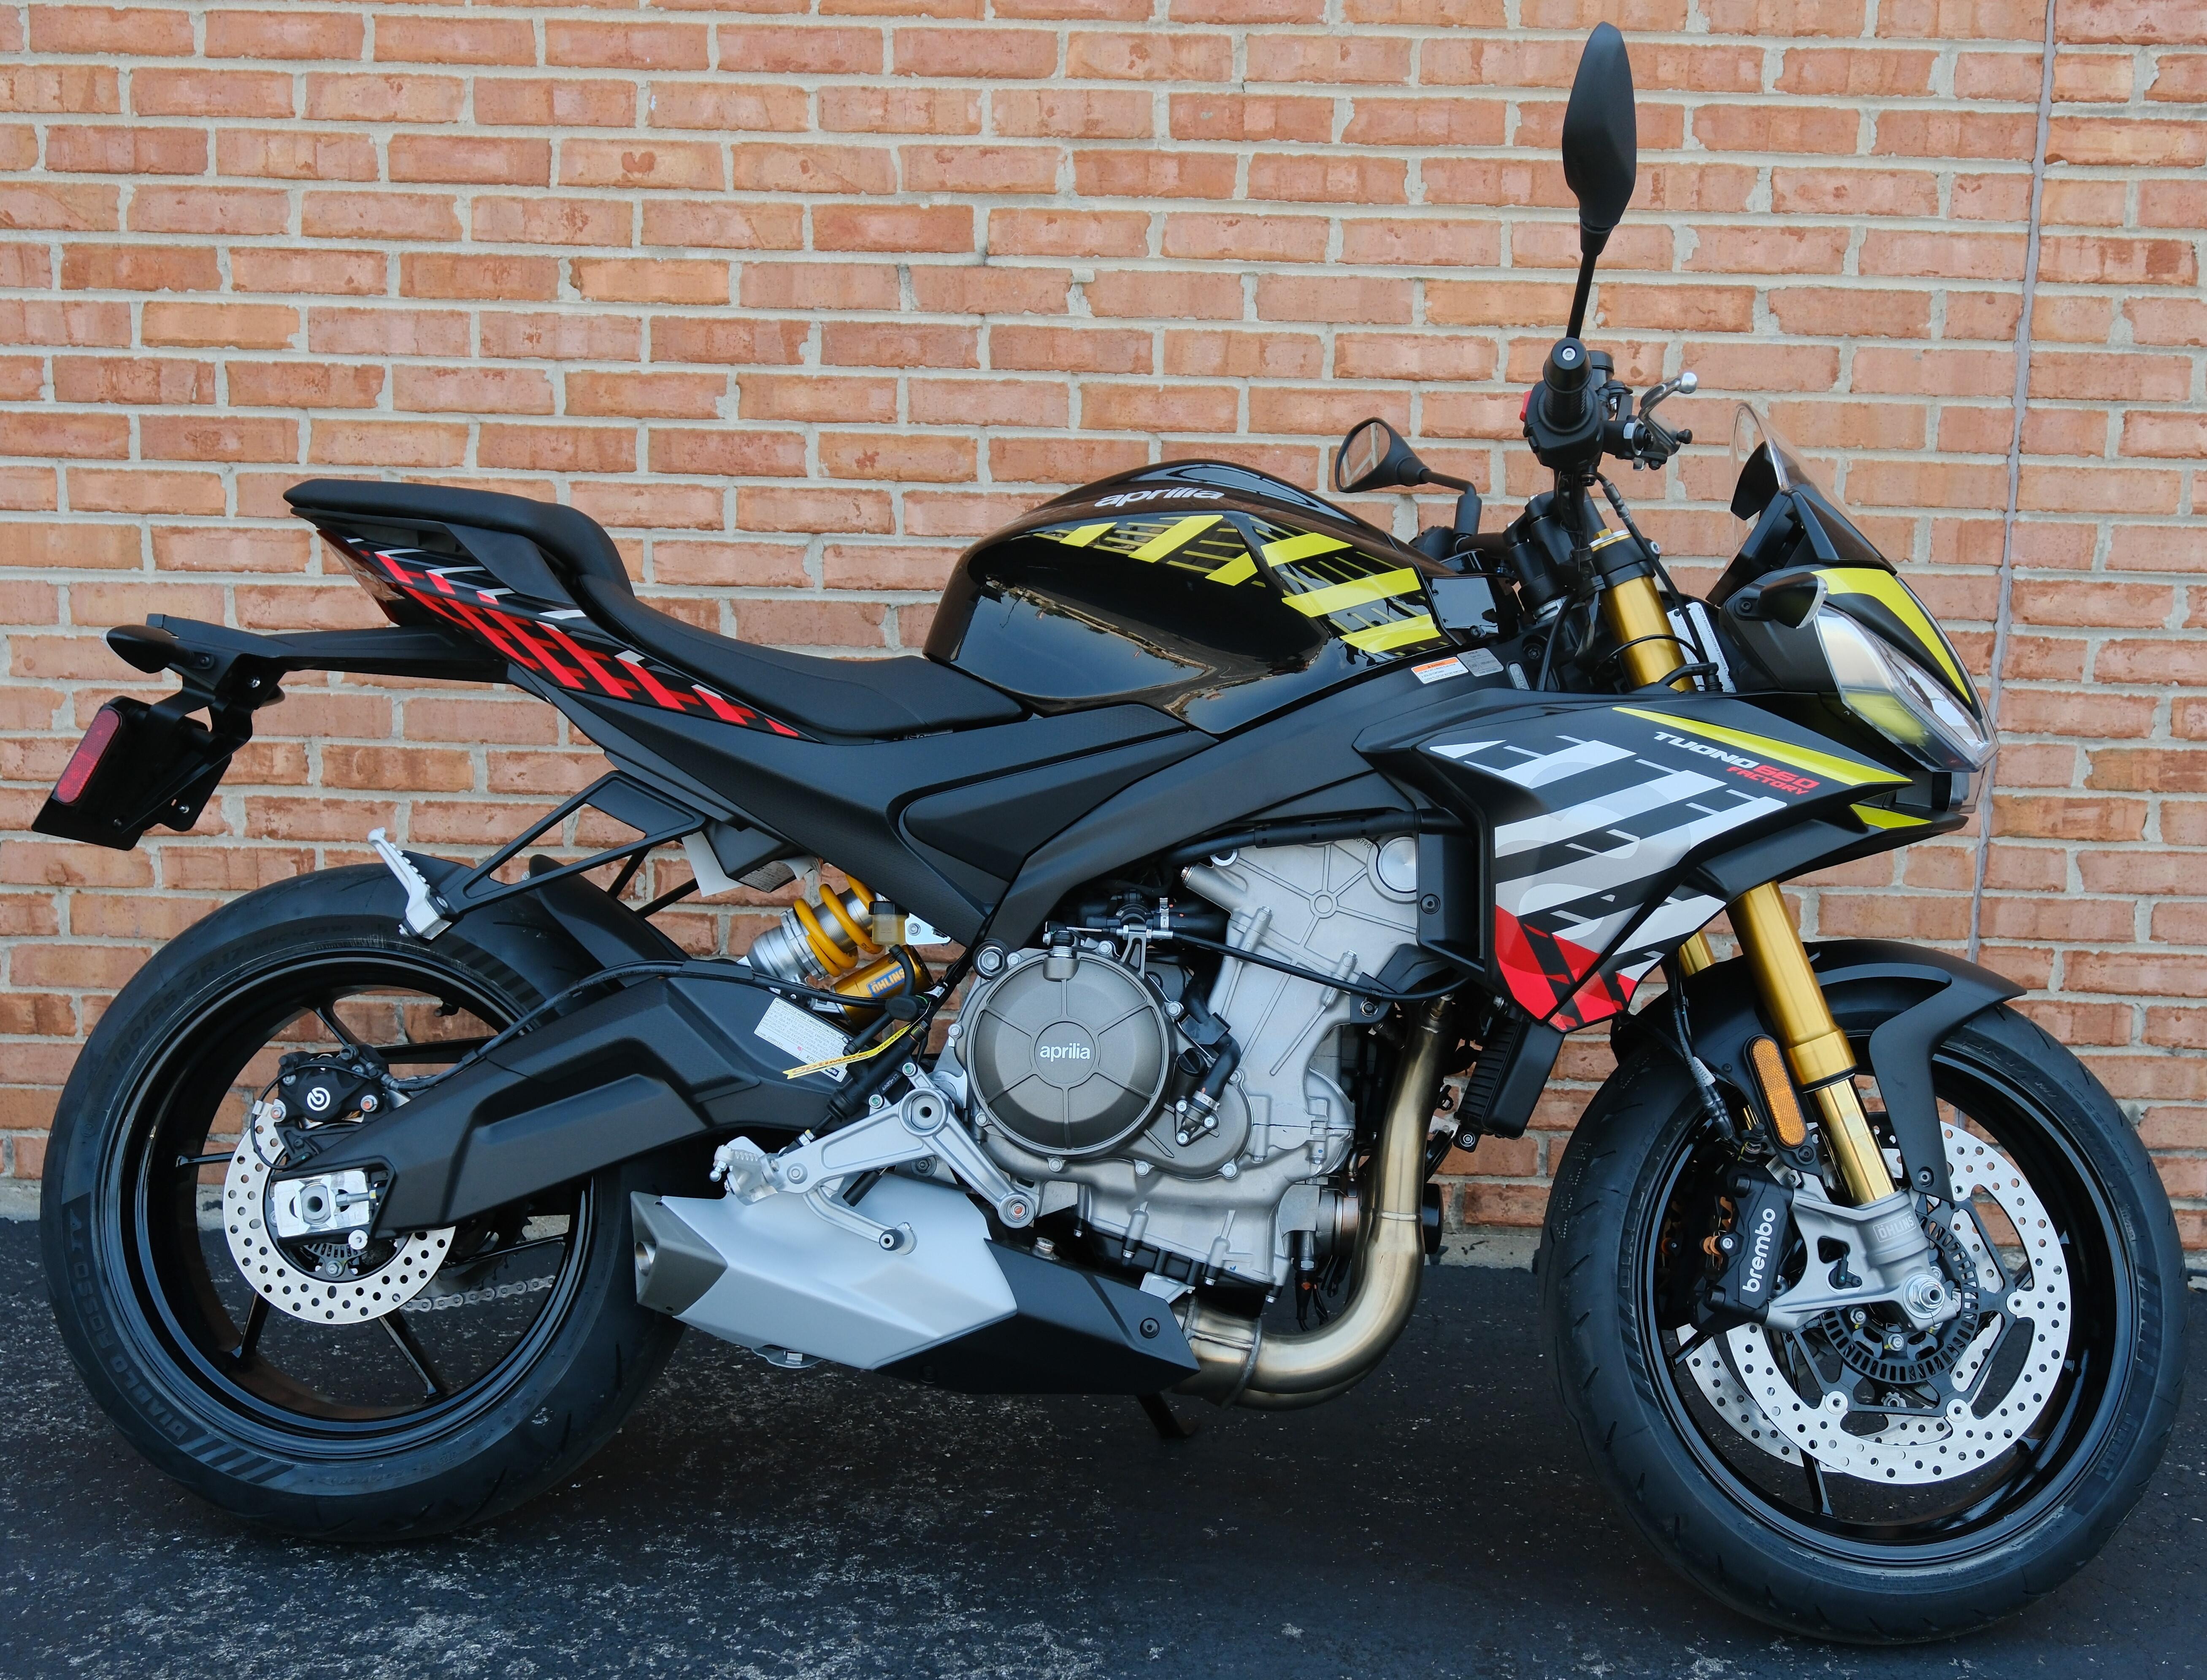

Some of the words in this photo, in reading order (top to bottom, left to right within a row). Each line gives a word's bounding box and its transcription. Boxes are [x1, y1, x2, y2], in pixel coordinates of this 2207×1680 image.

[1095, 487, 1225, 507] aprilia
[1726, 766, 1810, 795] FACTORY
[1353, 837, 1371, 849] 0790
[871, 968, 905, 994] ÖHLINS
[775, 1000, 797, 1015] MOTORCYCLE
[796, 1012, 806, 1020] NOISE
[806, 1018, 822, 1029] EMISSION
[822, 1026, 838, 1037] CONTROL
[805, 1054, 817, 1063] XGU
[1039, 1043, 1091, 1062] aprilia
[2064, 1079, 2115, 1137] ROSSO
[1877, 1215, 1915, 1241] ÖHLINS
[1742, 1208, 1776, 1293] brembo
[73, 1263, 115, 1350] ROSSO
[110, 1354, 190, 1441] DIABLO
